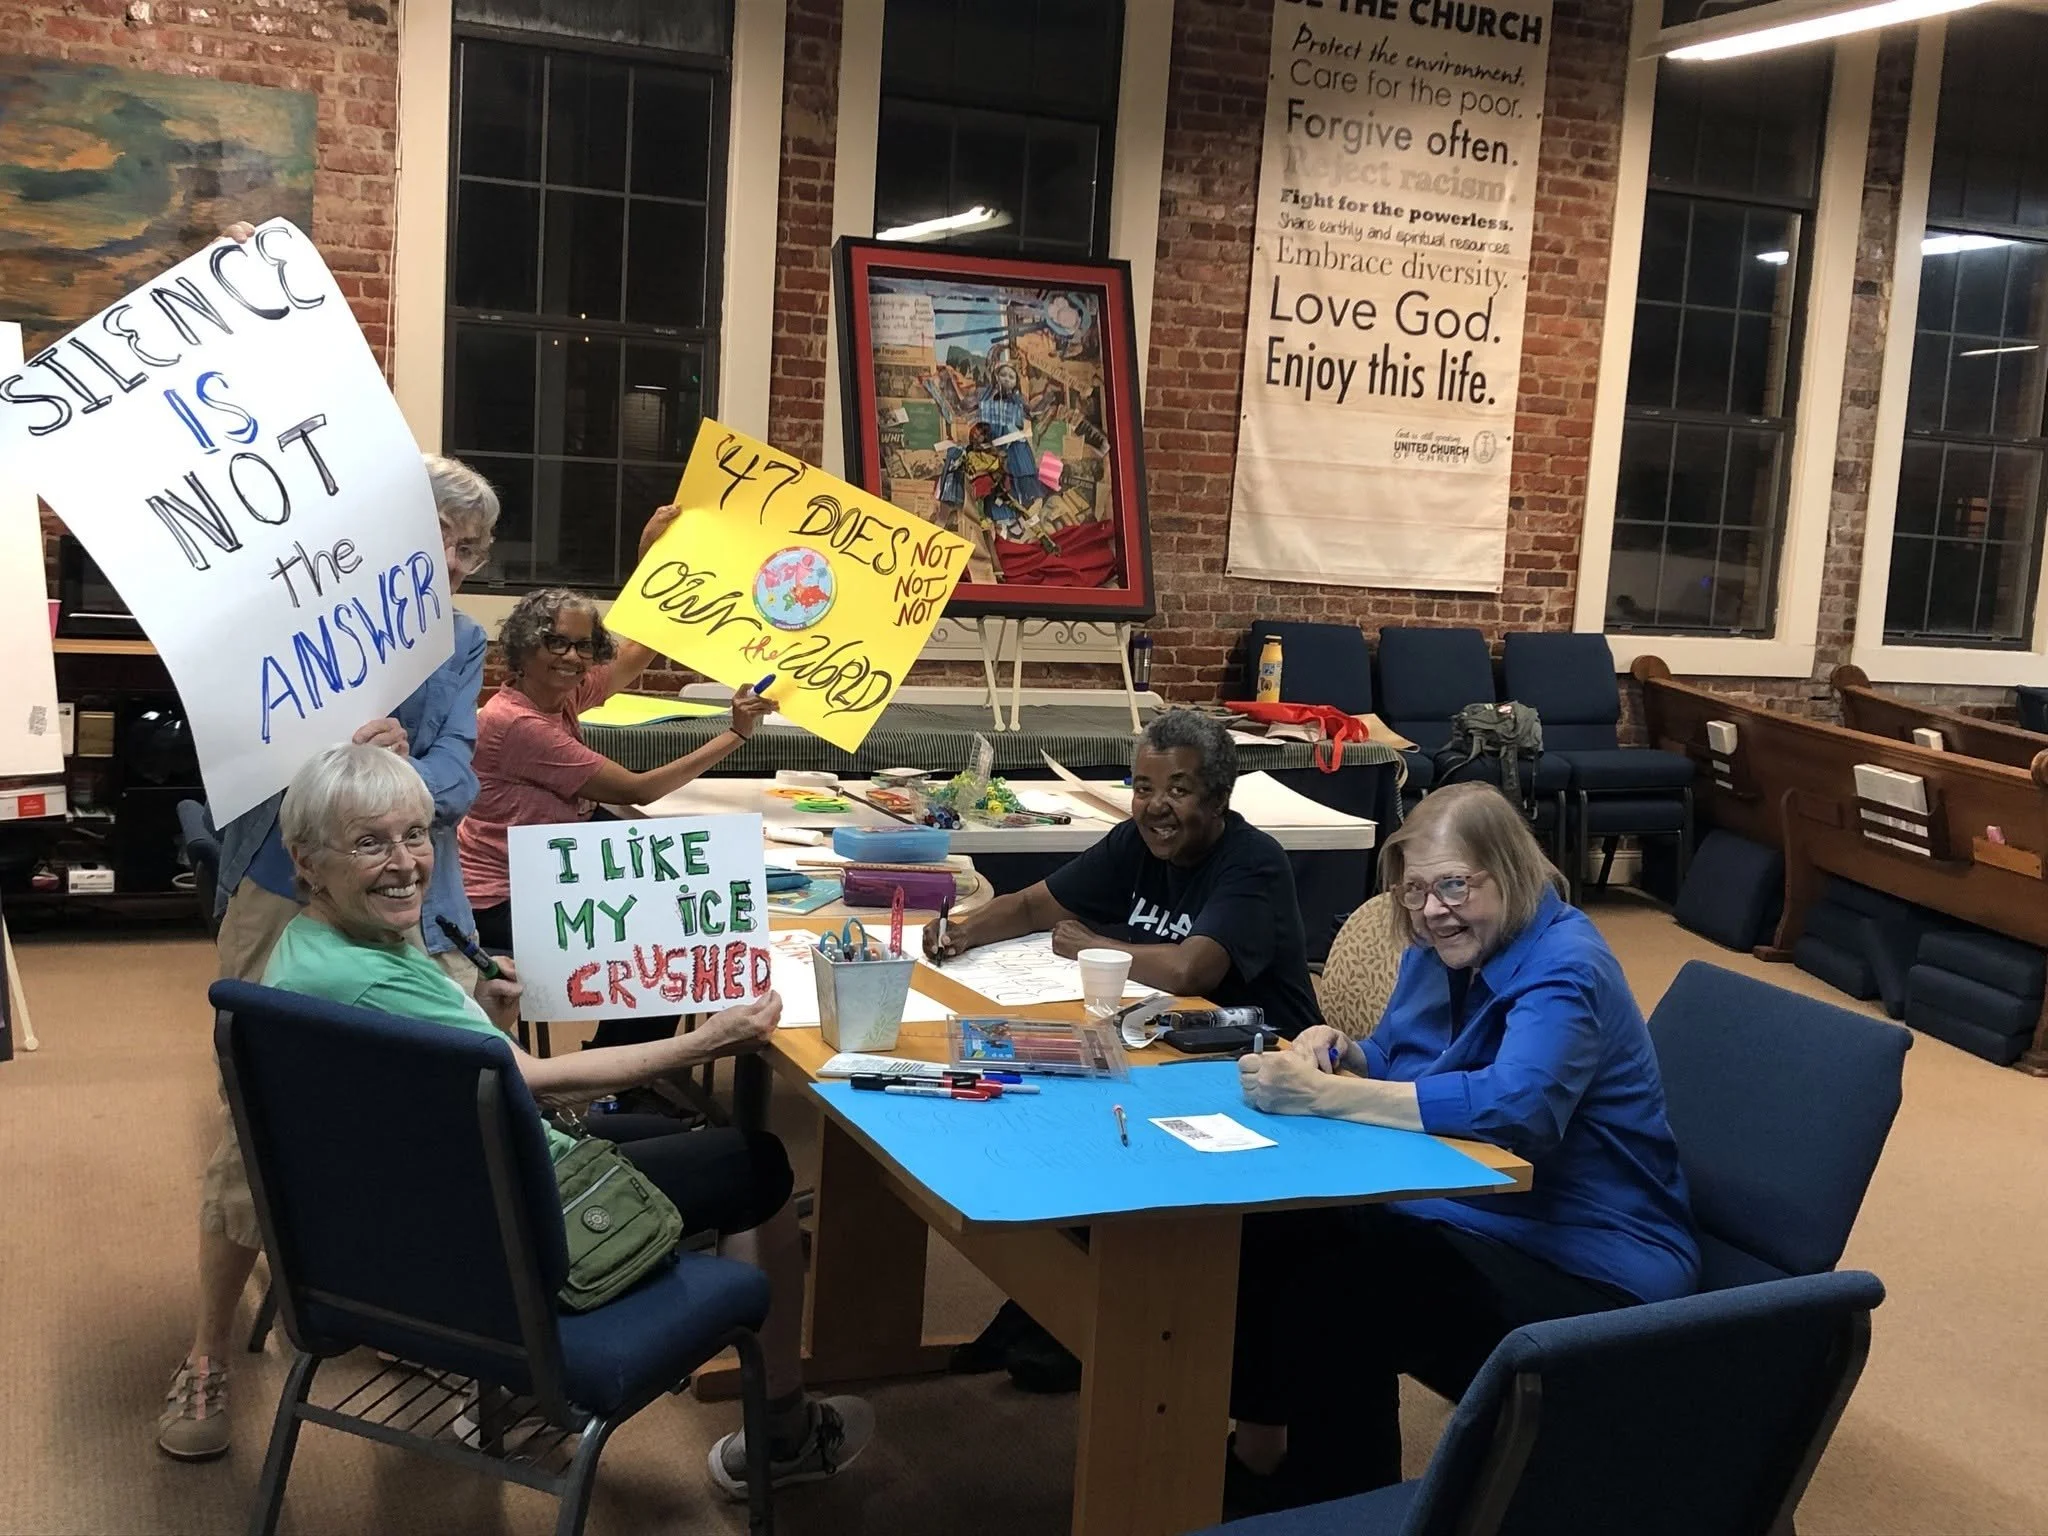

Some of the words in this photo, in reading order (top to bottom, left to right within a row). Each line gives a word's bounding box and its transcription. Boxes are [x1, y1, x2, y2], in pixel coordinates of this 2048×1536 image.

[1409, 0, 1543, 45] CHURCH
[1291, 22, 1362, 61] Protect
[1368, 36, 1399, 65] the
[1407, 52, 1525, 87] environment.
[1290, 58, 1358, 93] Care
[1368, 69, 1400, 98] for
[1411, 75, 1451, 107] the
[1460, 90, 1523, 119] poor.
[1287, 98, 1413, 154] Forgive
[1427, 119, 1519, 166] often.
[1278, 211, 1317, 231] Share
[1320, 219, 1363, 242] earthly
[1367, 225, 1392, 241] and
[1280, 188, 1335, 210] Fight
[1338, 195, 1369, 213] for
[1372, 200, 1404, 218] the
[1409, 208, 1514, 232] powerless.
[1277, 236, 1392, 277] Embrace
[1402, 252, 1508, 298] diversity.
[0, 226, 325, 436] SILENCE
[1270, 275, 1376, 330] Love
[1395, 290, 1501, 343] God.
[1266, 336, 1357, 404] Enjoy
[1368, 343, 1425, 398] this
[1437, 349, 1496, 405] life.
[163, 371, 259, 455] IS
[1394, 440, 1428, 453] UNITED
[1430, 443, 1469, 456] CHURCH
[145, 414, 339, 571] NOT
[789, 494, 910, 576] DOES
[910, 530, 964, 570] NOT
[269, 537, 364, 608] the
[894, 569, 947, 603] NOT
[892, 584, 947, 627] NOT
[260, 550, 441, 744] ANSWER
[739, 635, 802, 664] the
[547, 837, 579, 884] I
[554, 893, 638, 951] MY
[566, 940, 772, 1009] CRUSHED
